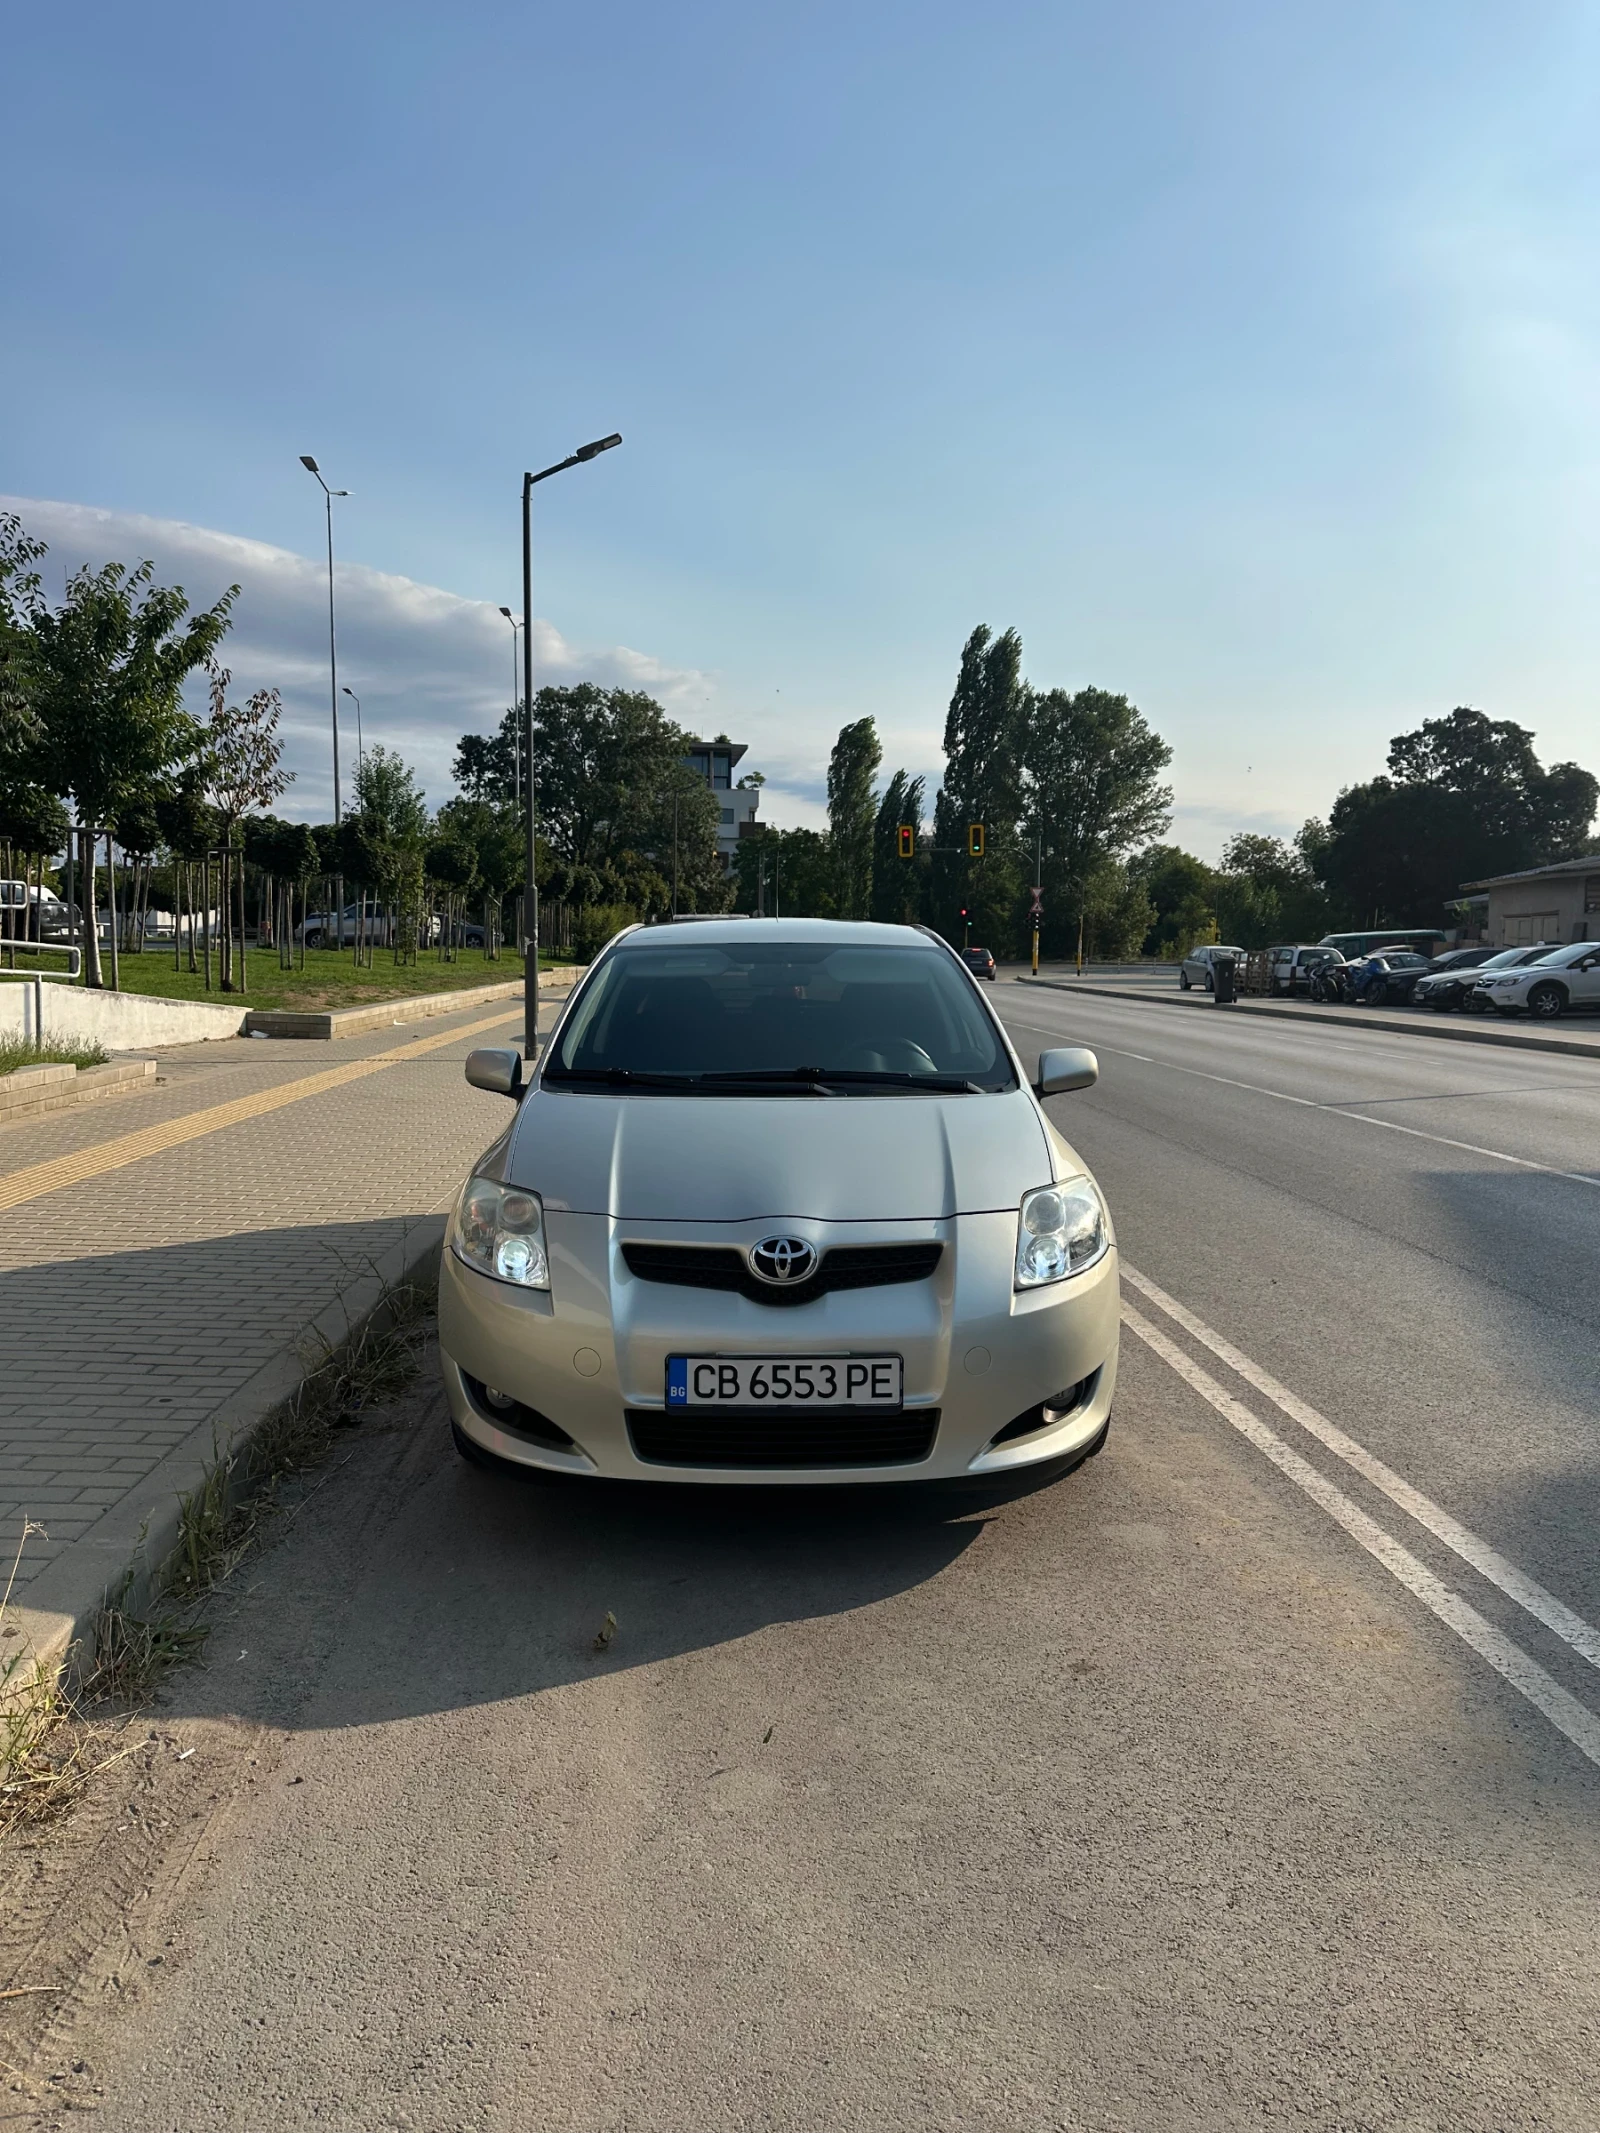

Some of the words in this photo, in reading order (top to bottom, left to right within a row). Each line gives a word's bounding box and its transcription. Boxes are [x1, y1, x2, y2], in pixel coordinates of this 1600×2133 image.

[670, 1386, 686, 1397] BG
[694, 1364, 740, 1399] CB
[750, 1364, 837, 1399] 6553
[846, 1363, 893, 1398] PE
